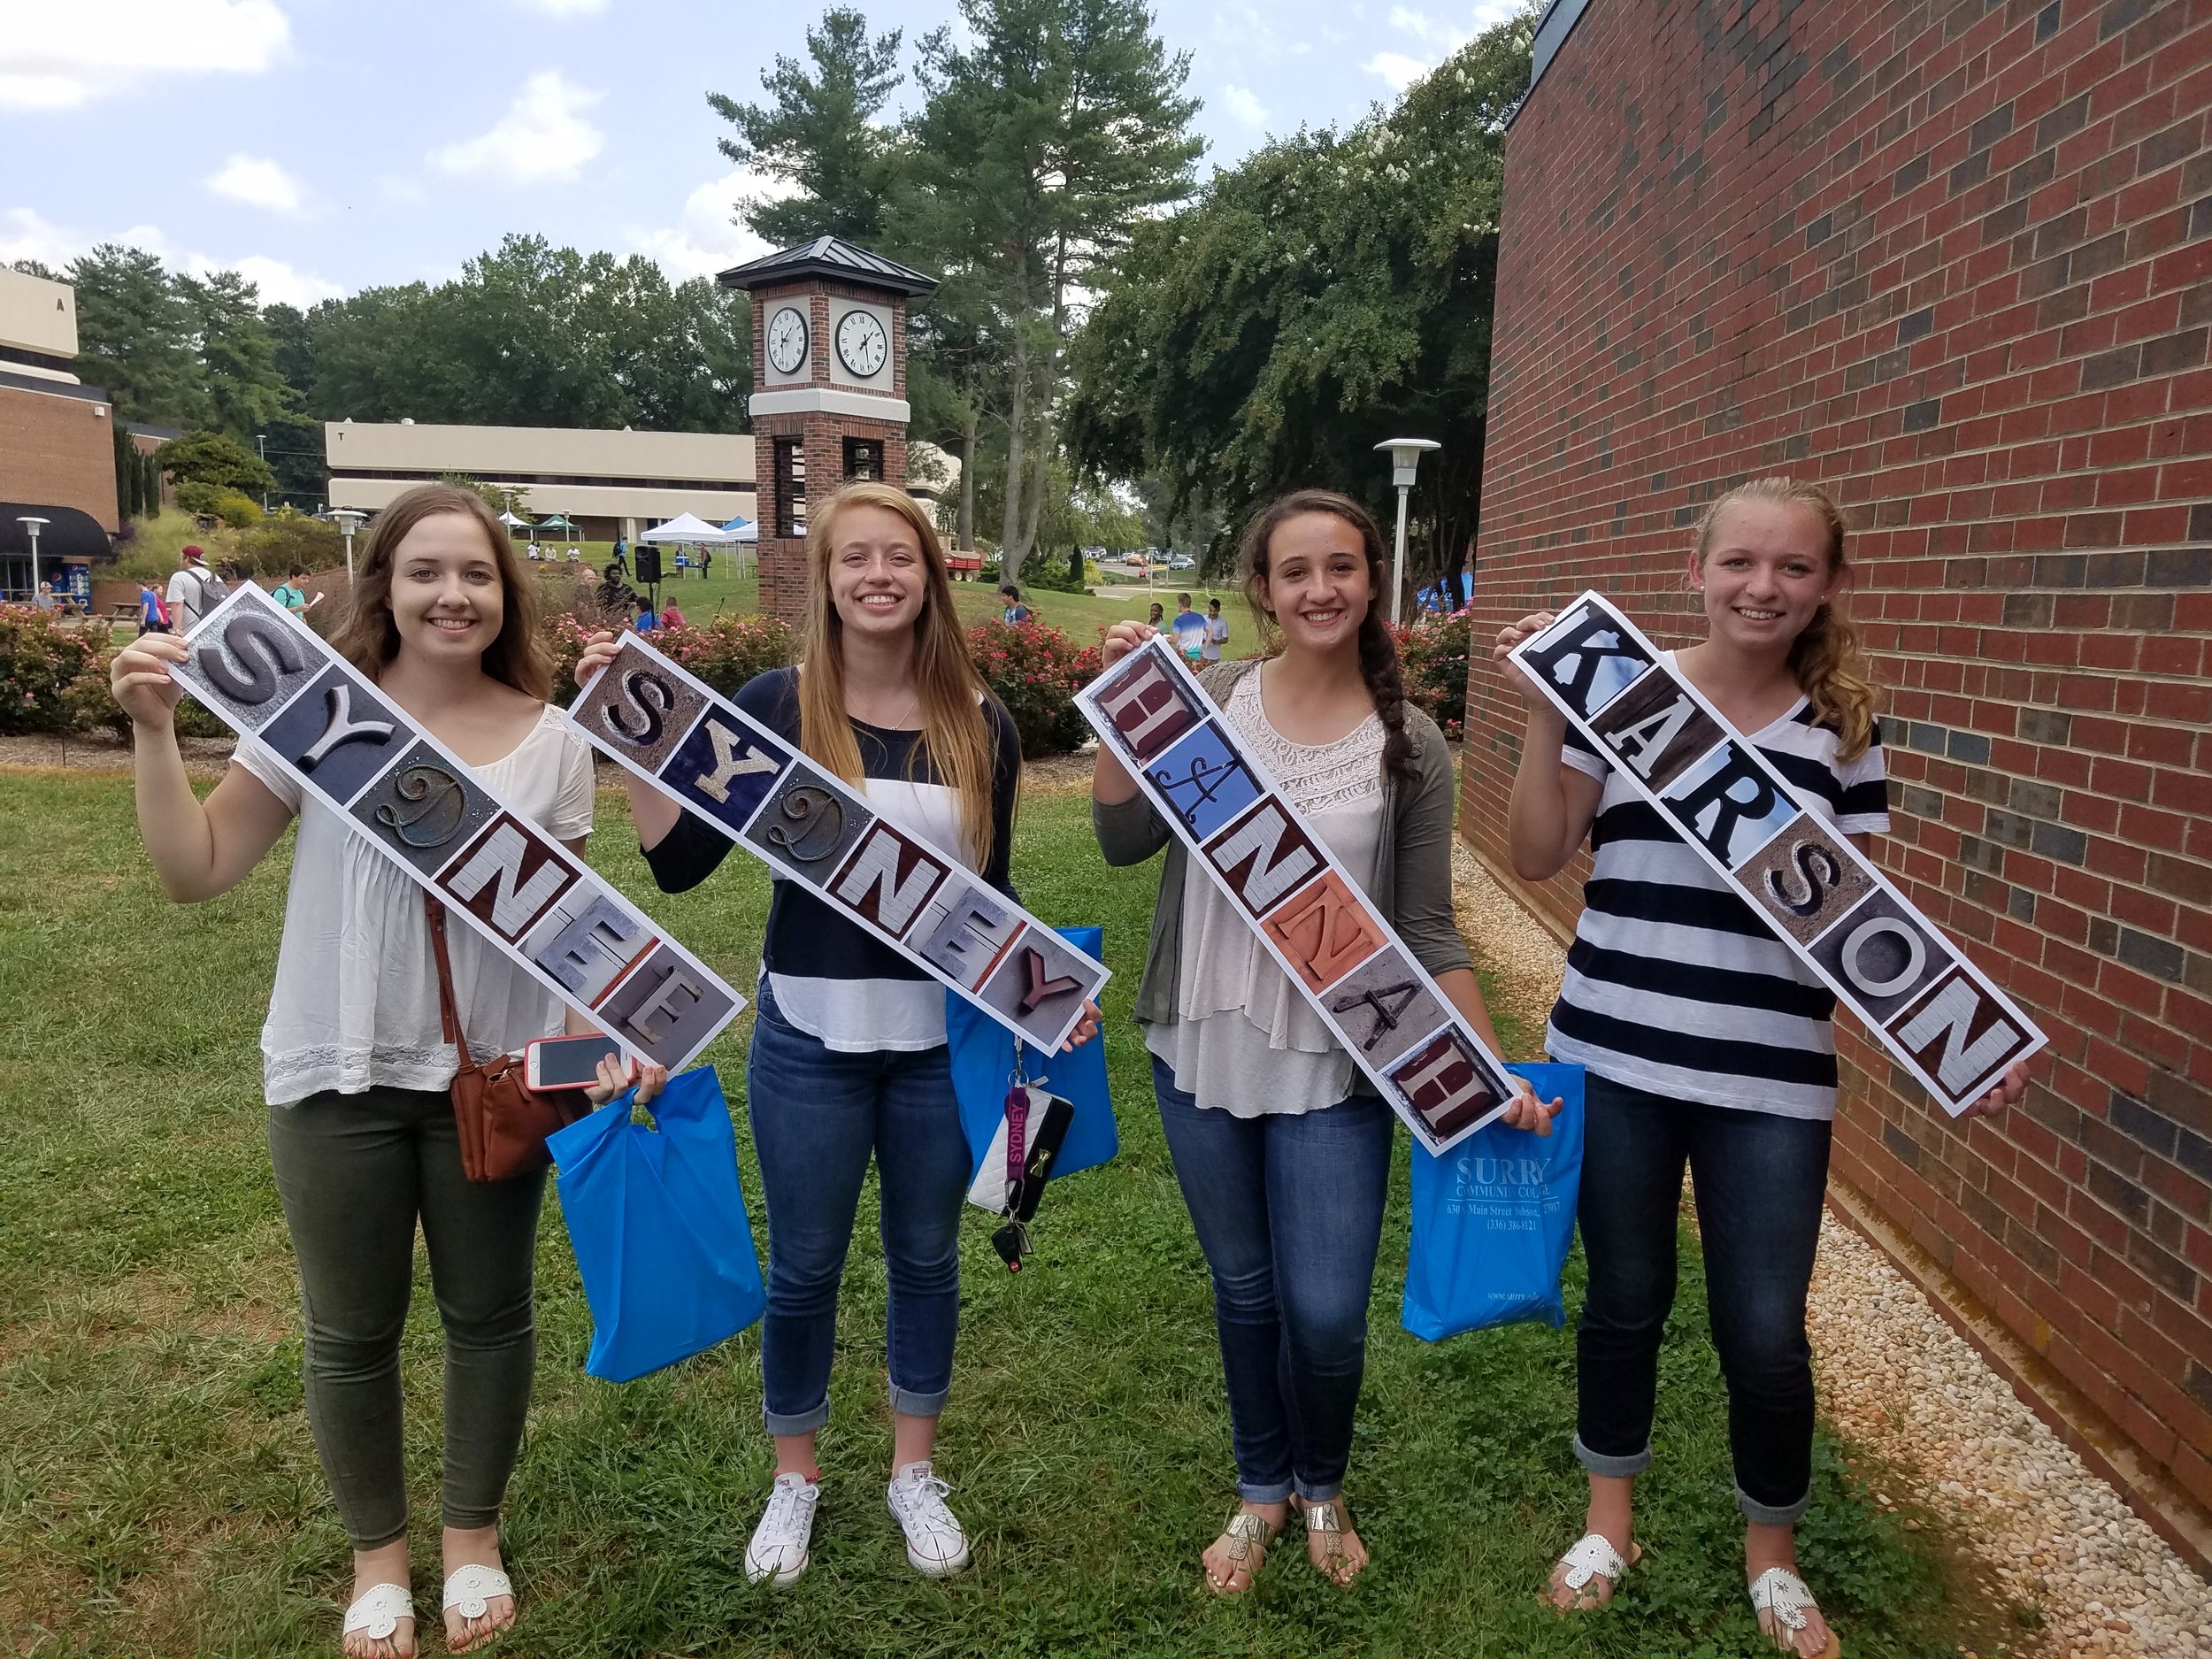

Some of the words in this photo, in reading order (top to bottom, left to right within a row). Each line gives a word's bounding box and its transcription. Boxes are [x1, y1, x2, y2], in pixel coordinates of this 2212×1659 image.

[56, 297, 65, 312] A
[337, 432, 345, 442] T
[196, 614, 706, 1046] SYDNEE
[599, 667, 1085, 1013] SYDNEY
[1099, 659, 1492, 1126] HANNAH
[1010, 1103, 1024, 1163] SYDNEY
[1456, 1157, 1552, 1185] SURRY
[1517, 1184, 1551, 1199] COLGE
[1447, 1203, 1461, 1215] 630
[1468, 1202, 1488, 1215] Main
[1490, 1204, 1512, 1217] Street
[1486, 1218, 1507, 1232] (336)
